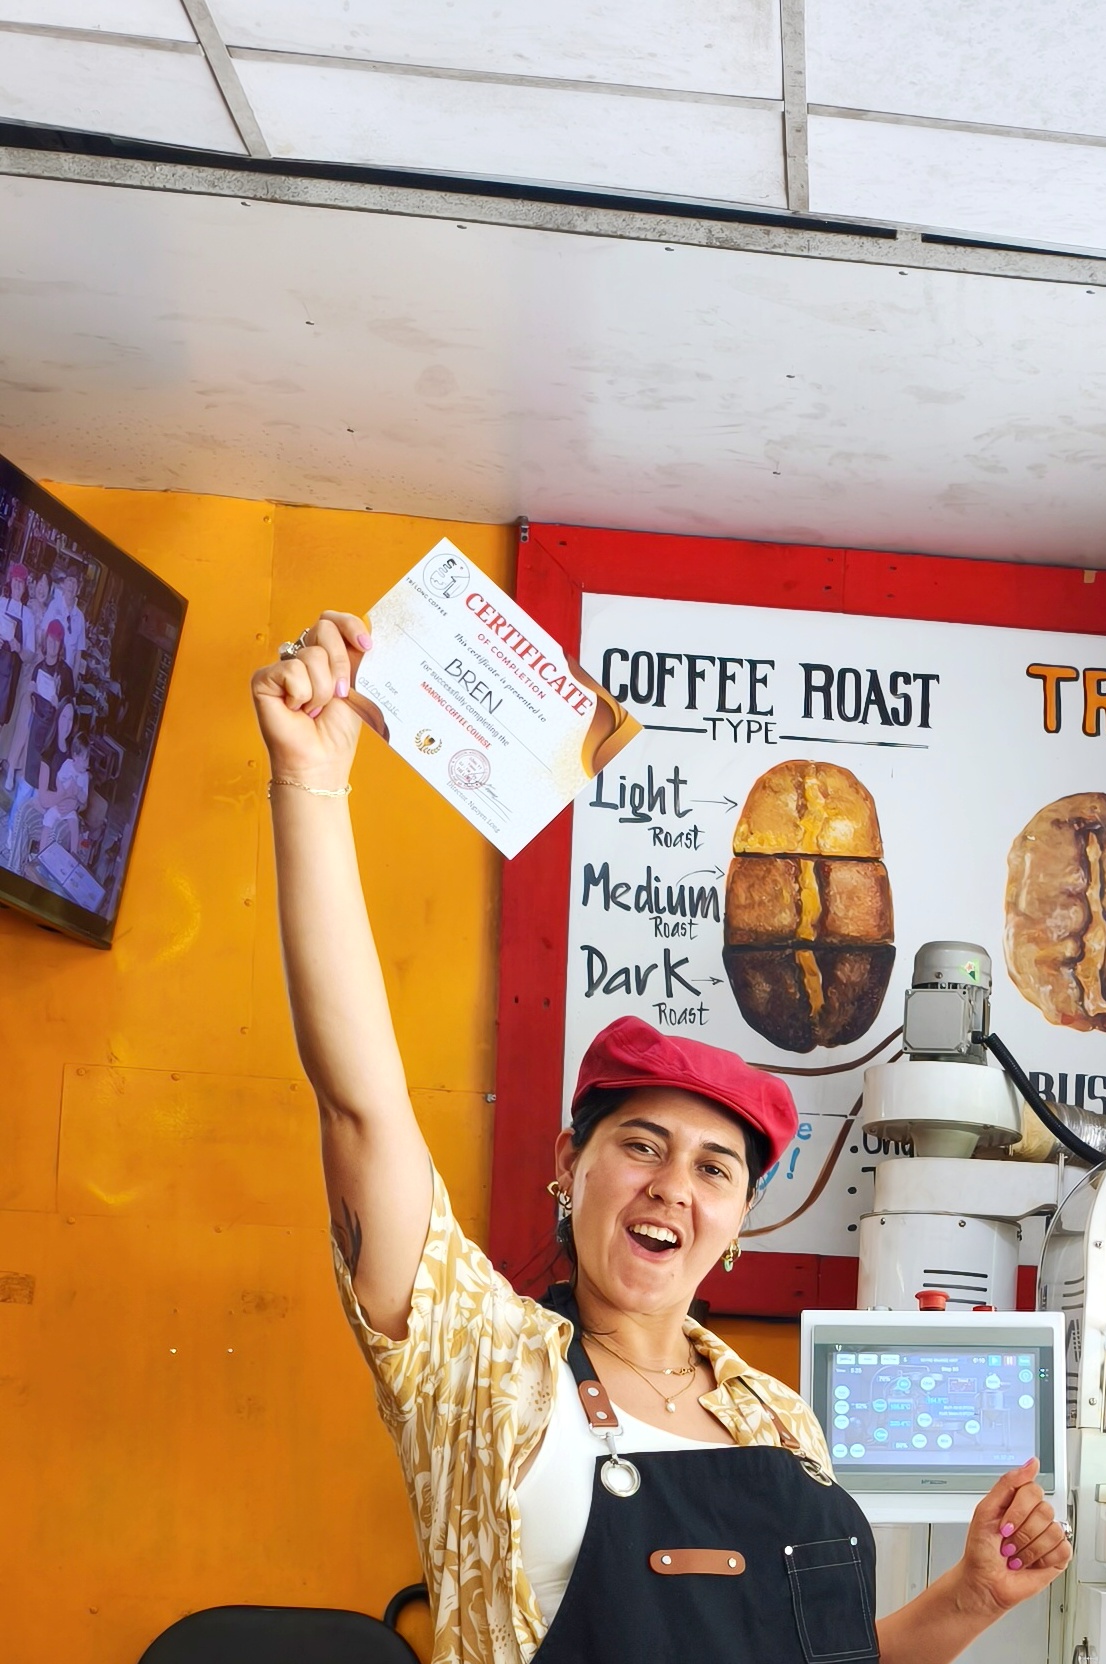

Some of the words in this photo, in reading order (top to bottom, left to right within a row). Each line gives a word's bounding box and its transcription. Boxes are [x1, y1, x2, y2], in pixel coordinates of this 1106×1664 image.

[453, 632, 469, 647] This
[465, 644, 501, 679] certificate
[504, 681, 539, 716] presented
[465, 592, 593, 716] CERTIFICATE
[476, 632, 491, 646] OF
[490, 645, 546, 699] COMPLETION
[419, 659, 433, 673] For
[429, 669, 467, 707] successfully
[463, 703, 500, 738] completing
[419, 680, 447, 707] MAKING
[443, 703, 468, 727] COFFEE
[464, 723, 492, 750] COURSE
[443, 655, 504, 715] BREN
[602, 648, 775, 717] COFFEE
[799, 662, 940, 729] ROAST
[704, 718, 778, 745] TYPE
[589, 765, 694, 824] Light
[648, 825, 705, 850] Roast
[582, 862, 721, 923] Medium
[650, 916, 699, 940] Roast
[580, 944, 701, 999] Dark
[653, 1002, 710, 1026] Roast
